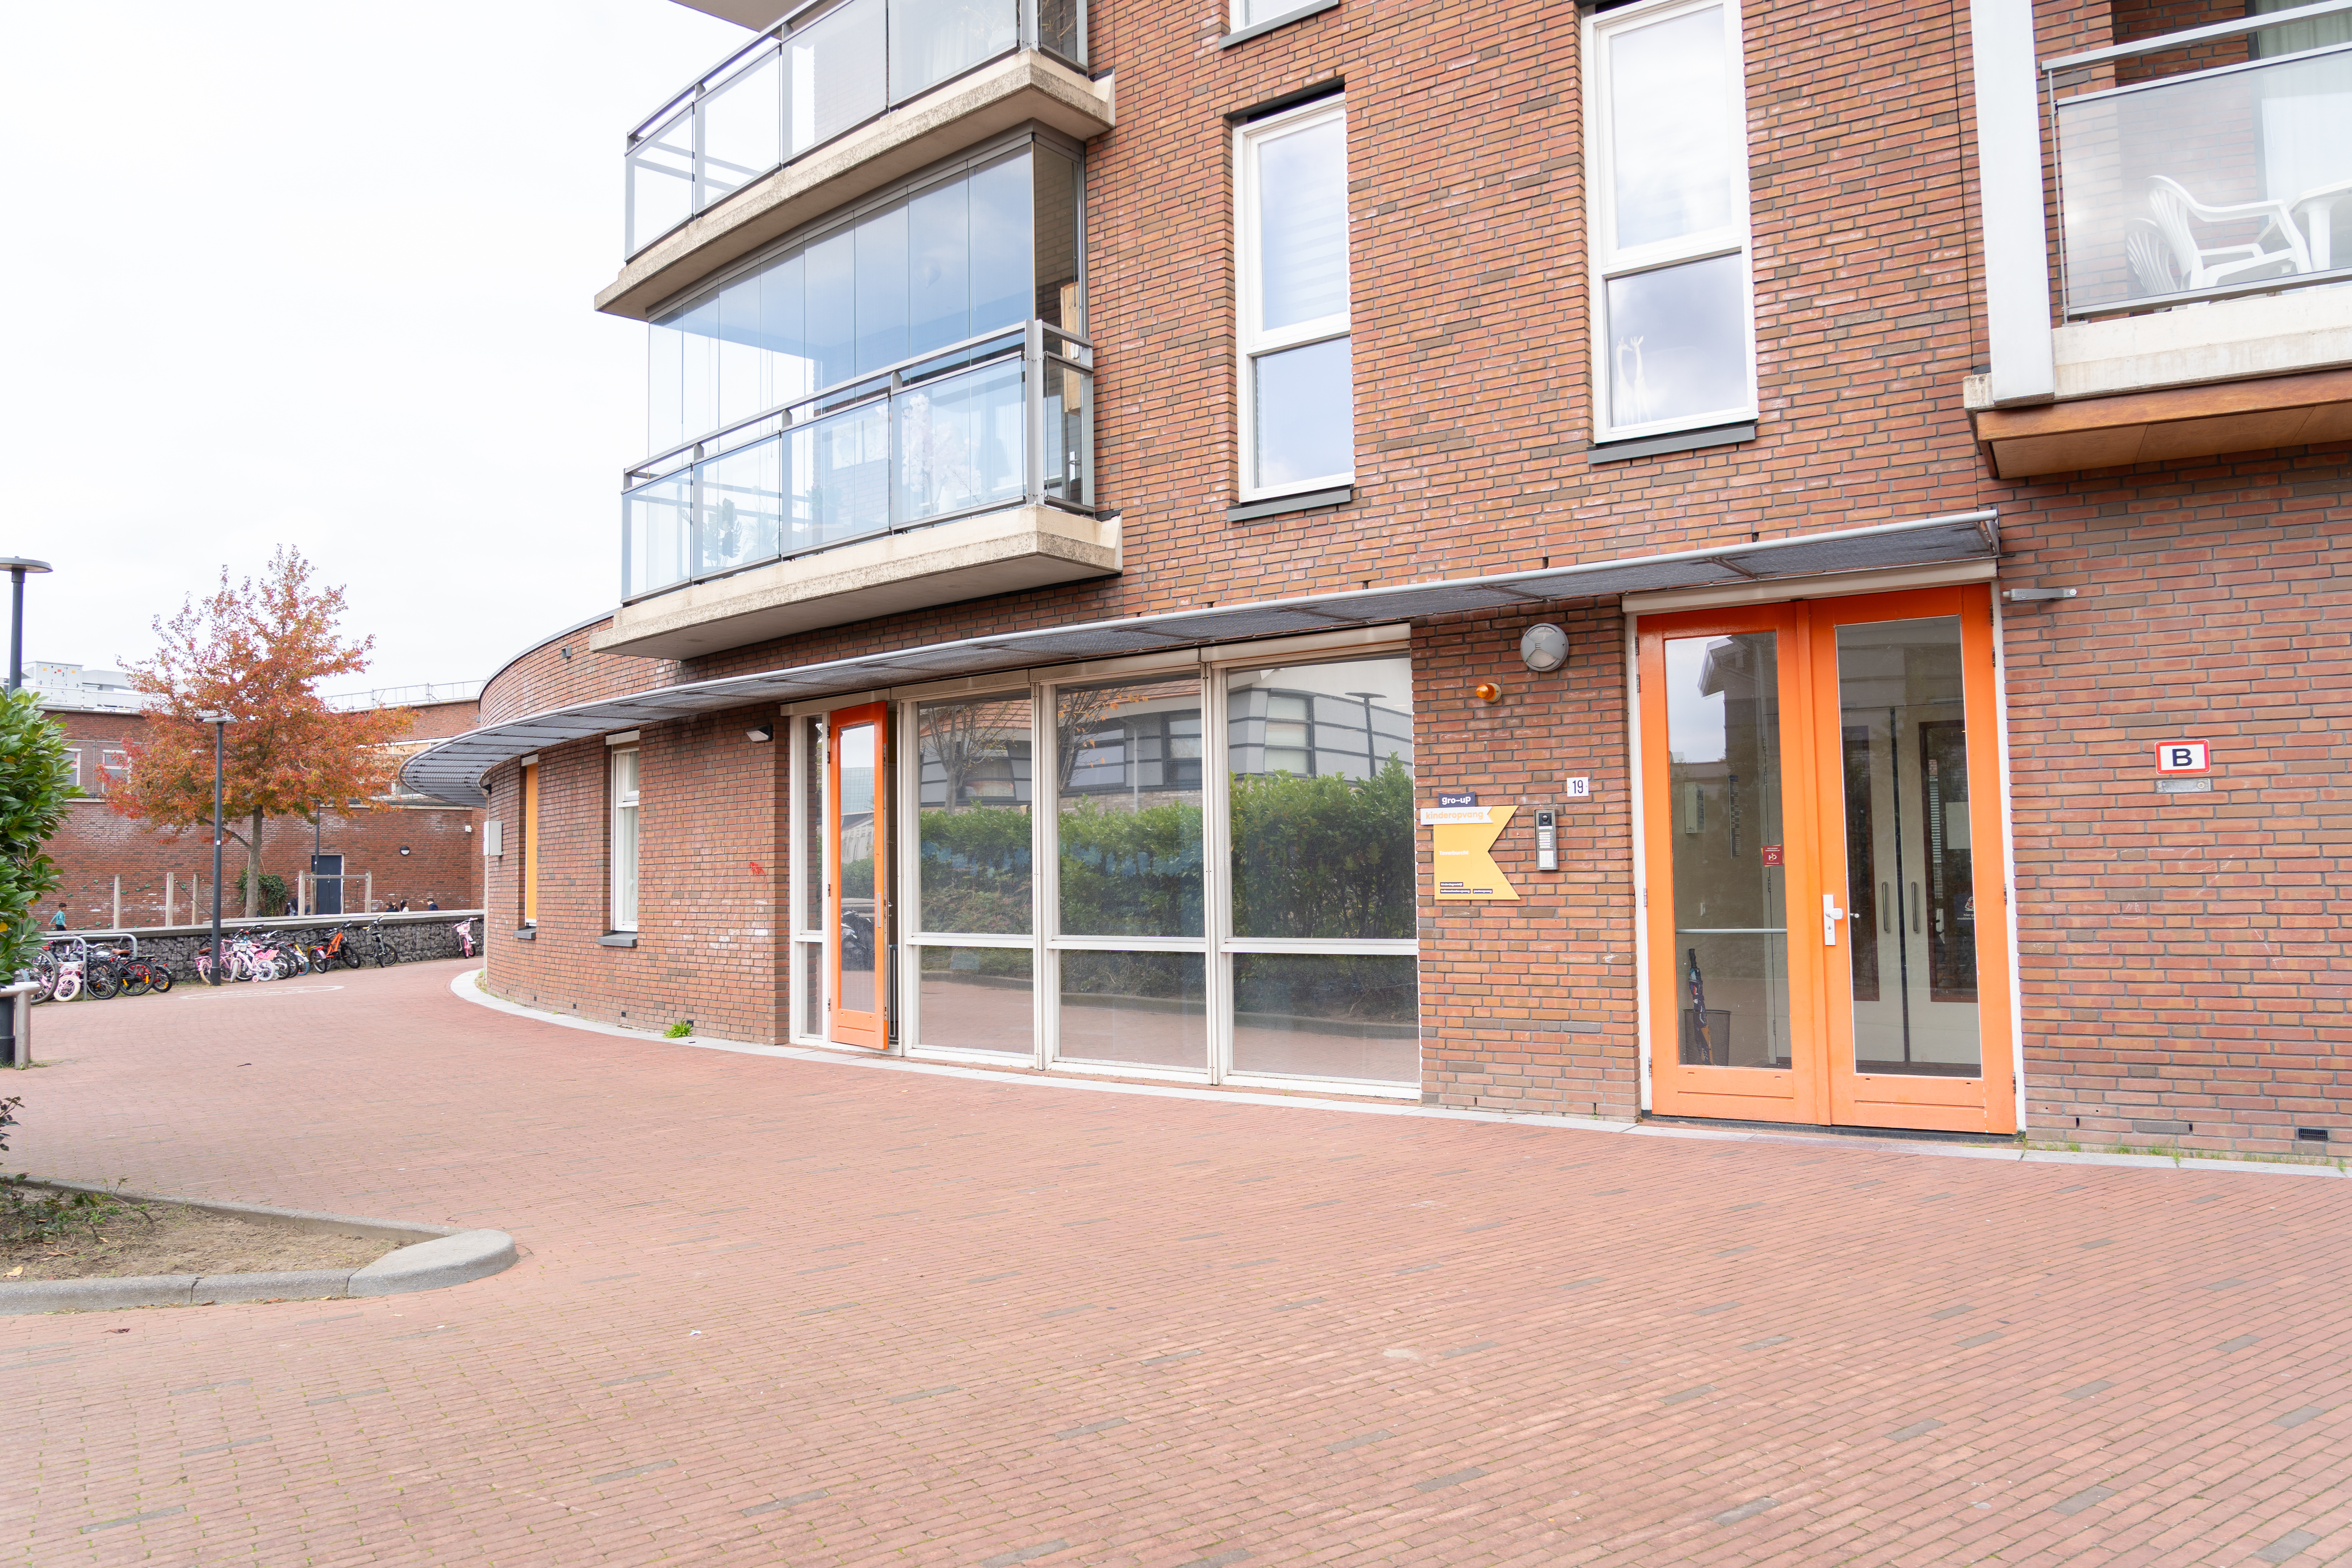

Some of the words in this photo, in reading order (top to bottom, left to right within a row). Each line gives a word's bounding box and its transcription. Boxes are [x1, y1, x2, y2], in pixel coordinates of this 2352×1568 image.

[2172, 748, 2192, 767] B
[1573, 780, 1583, 793] 19
[1442, 796, 1471, 805] gro-up
[1426, 812, 1483, 820] kinderopvang
